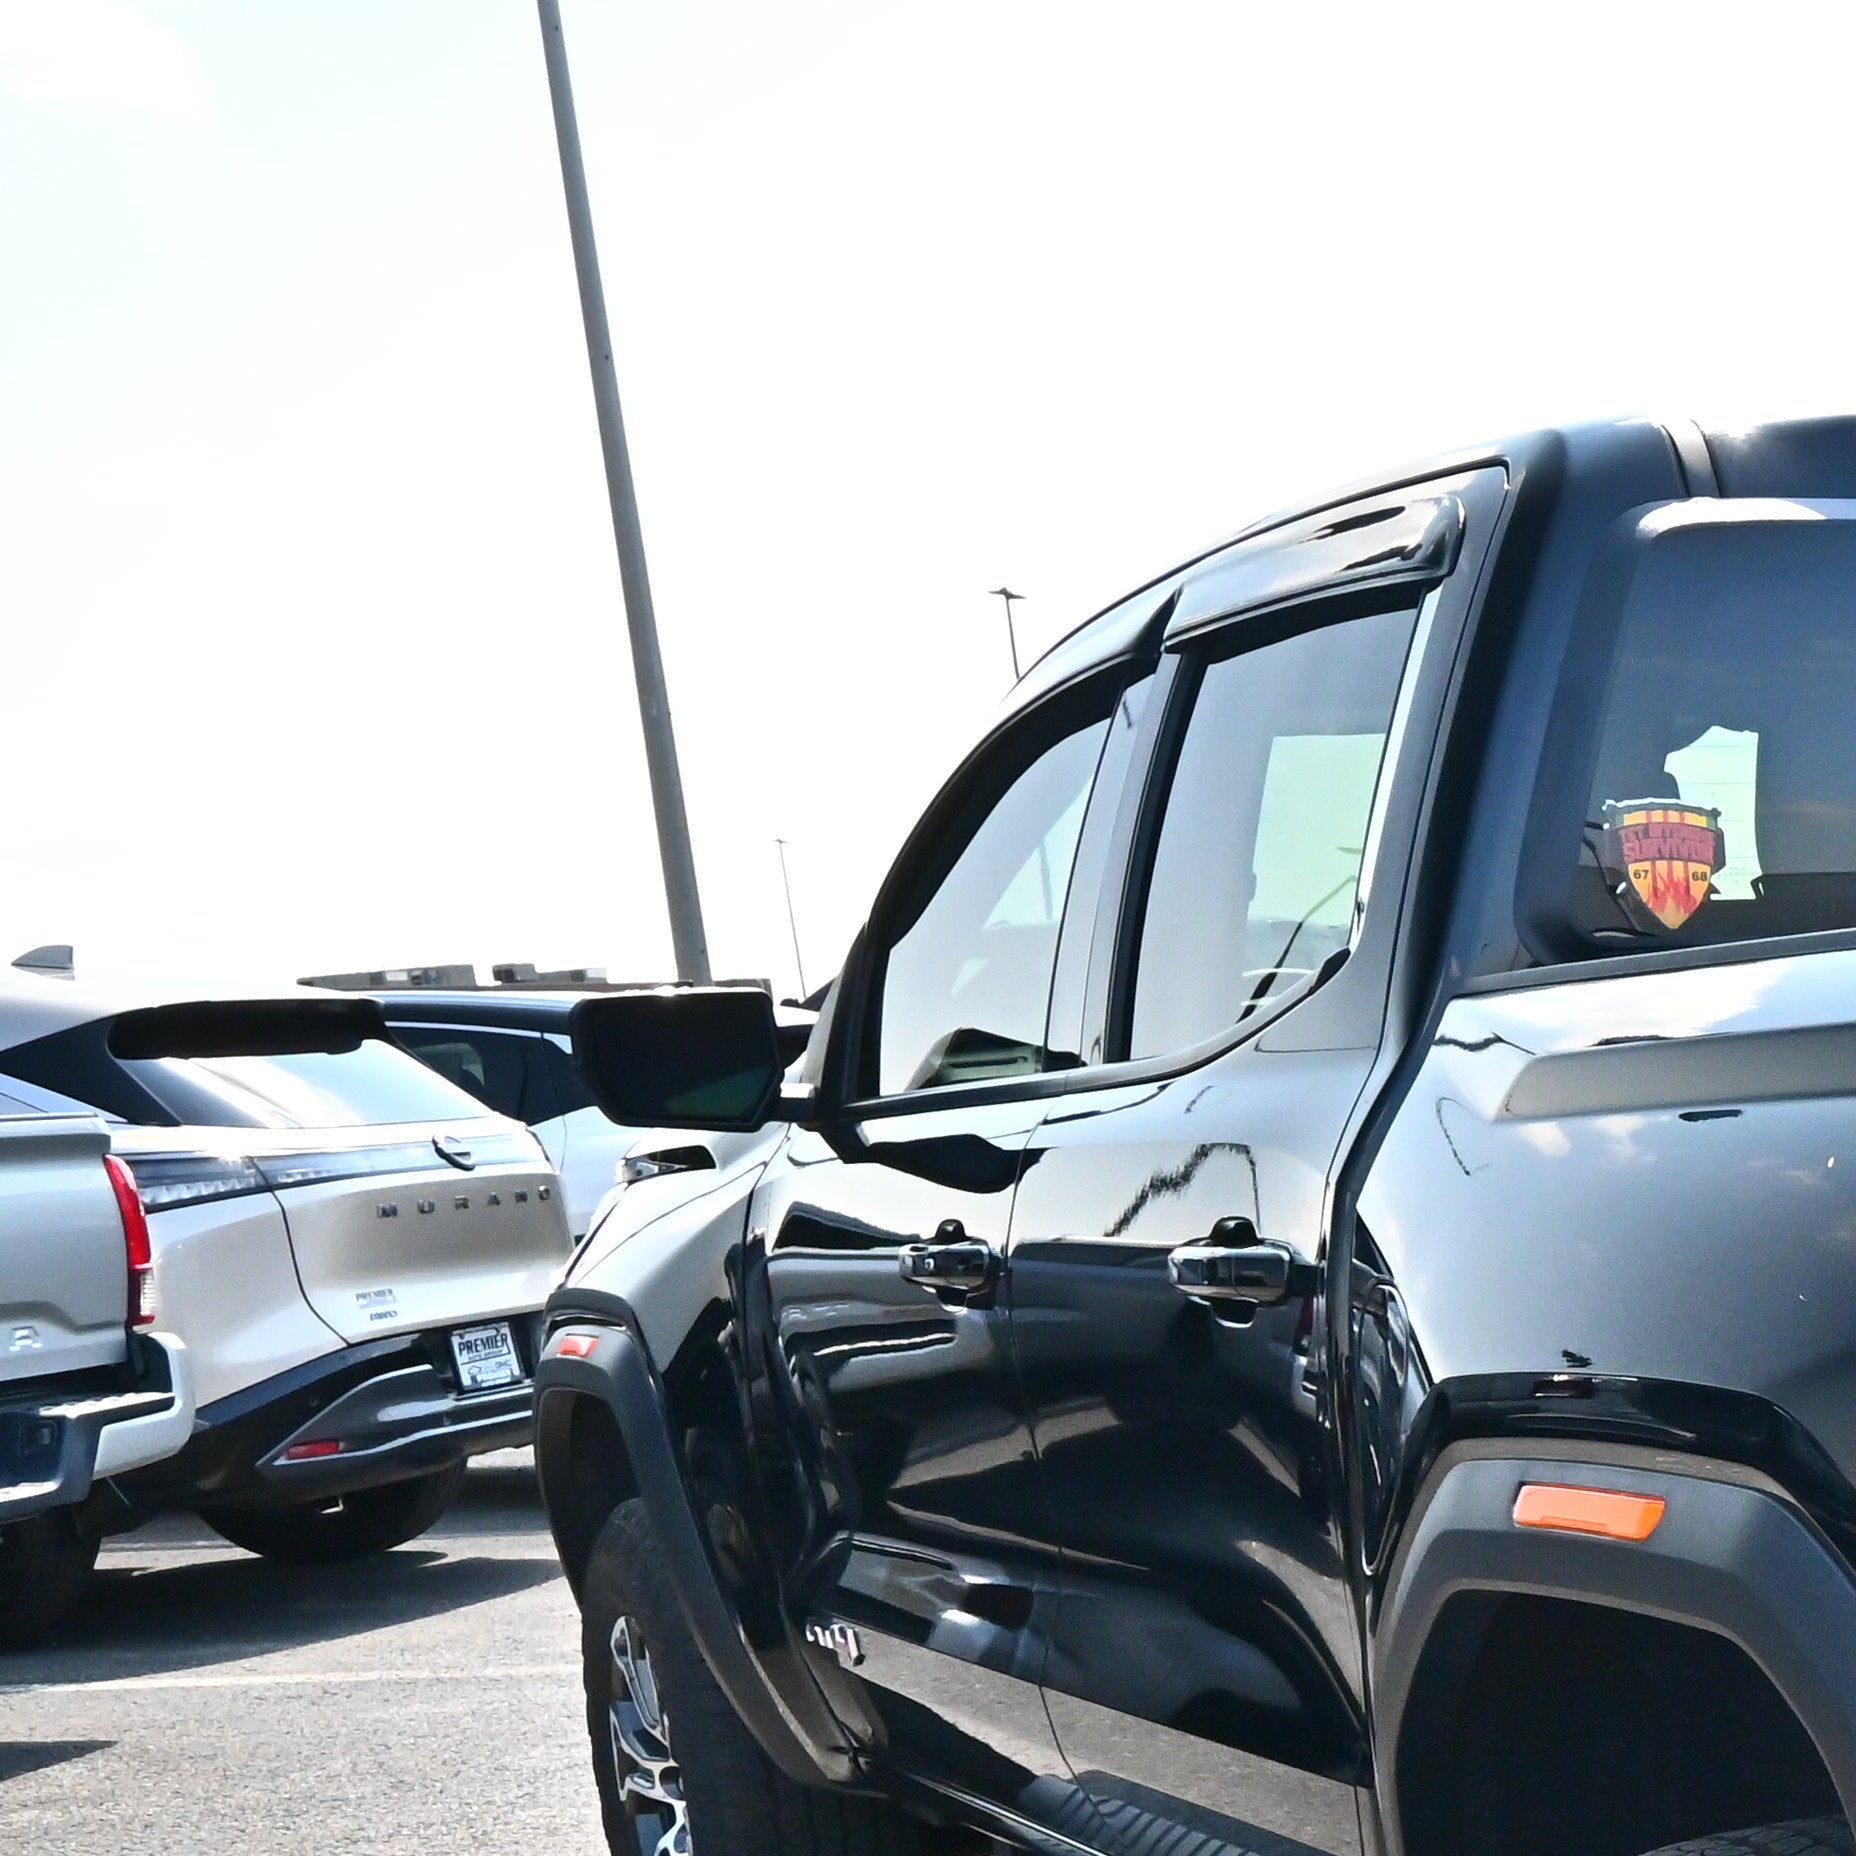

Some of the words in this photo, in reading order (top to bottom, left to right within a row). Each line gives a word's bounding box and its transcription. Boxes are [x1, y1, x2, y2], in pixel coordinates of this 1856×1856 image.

[1633, 868, 1650, 881] 67
[1691, 871, 1708, 882] 68
[376, 1184, 550, 1219] MURANO
[458, 1333, 510, 1356] PREMIER
